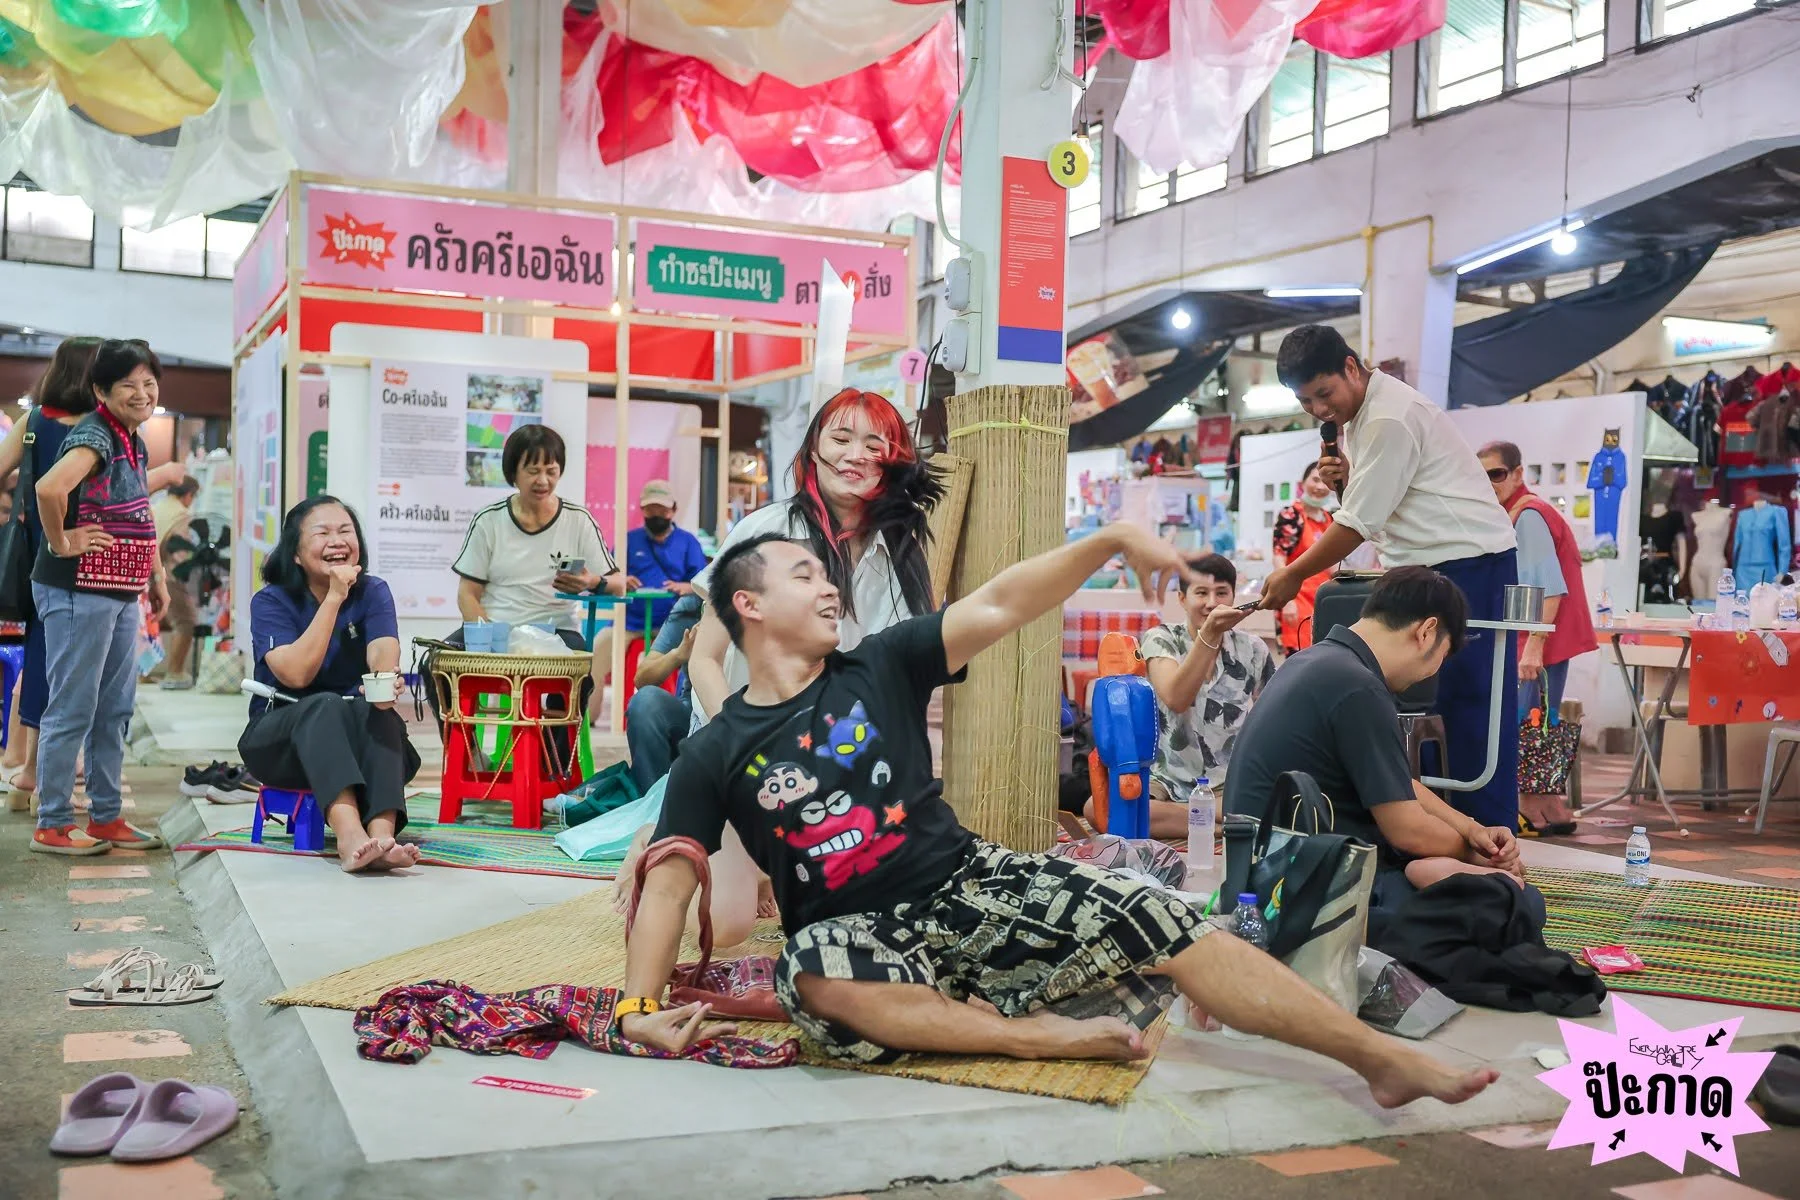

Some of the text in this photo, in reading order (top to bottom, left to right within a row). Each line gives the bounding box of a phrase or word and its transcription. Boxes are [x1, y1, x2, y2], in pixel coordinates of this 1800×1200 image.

[1062, 151, 1076, 176] 3
[407, 222, 604, 286] ครัวครีเอฉัน
[864, 261, 891, 299] สั่ง
[908, 358, 919, 376] 7
